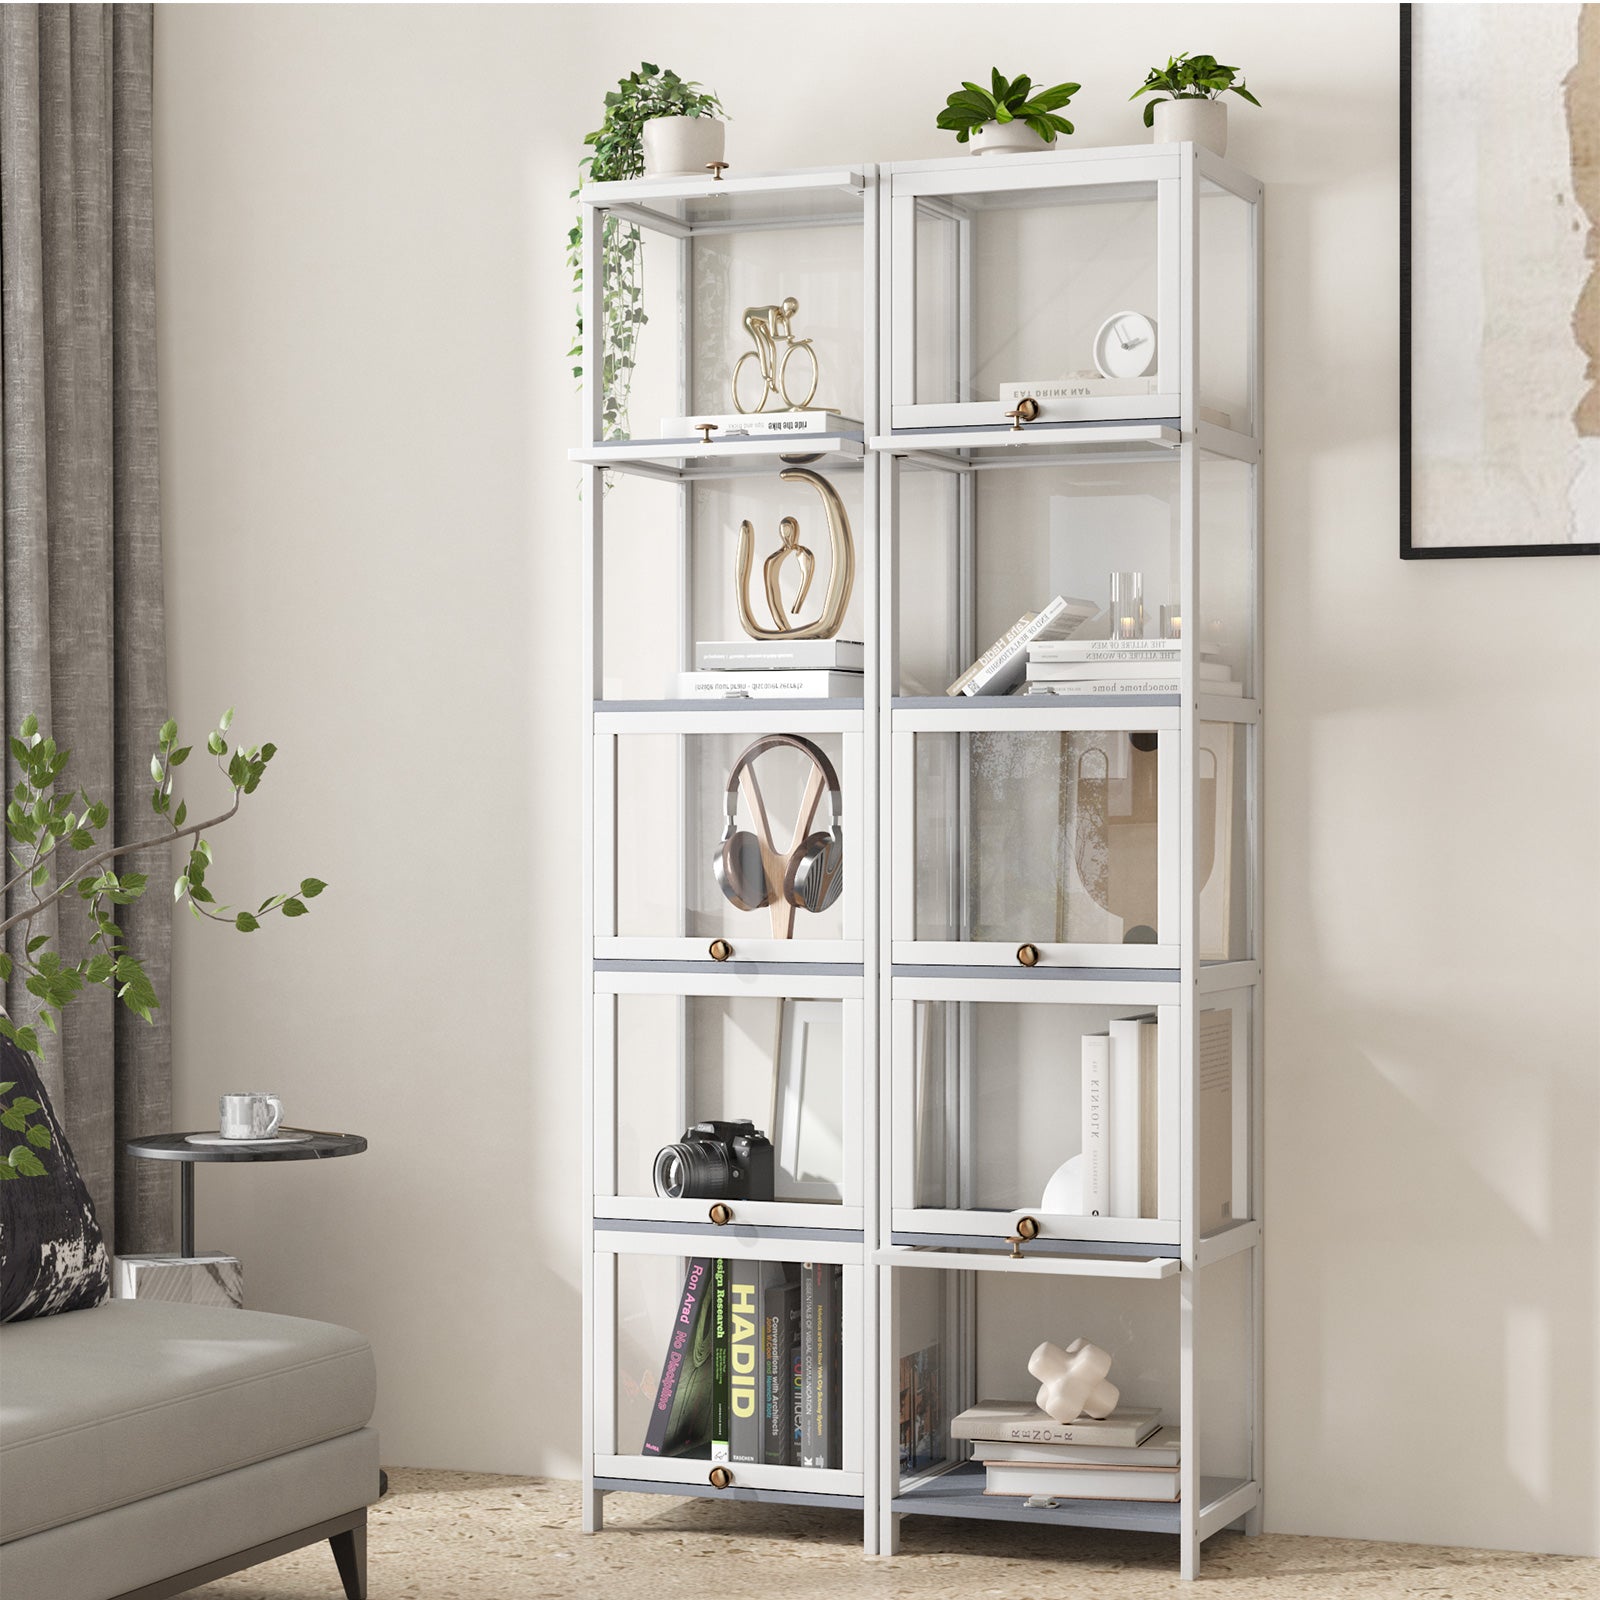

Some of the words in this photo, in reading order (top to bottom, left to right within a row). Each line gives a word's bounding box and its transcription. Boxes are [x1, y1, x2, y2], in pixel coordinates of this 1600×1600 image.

[768, 422, 782, 430] bike
[783, 422, 793, 430] the
[794, 421, 807, 429] ride
[688, 1265, 703, 1290] Ron
[715, 1258, 724, 1287] esign
[680, 1292, 695, 1324] Arad
[717, 1290, 725, 1338] Research
[806, 1320, 812, 1330] OF
[674, 1330, 687, 1349] No
[732, 1284, 755, 1418] HADID
[658, 1352, 682, 1410] Discipline
[1012, 1430, 1072, 1440] RENOIR
